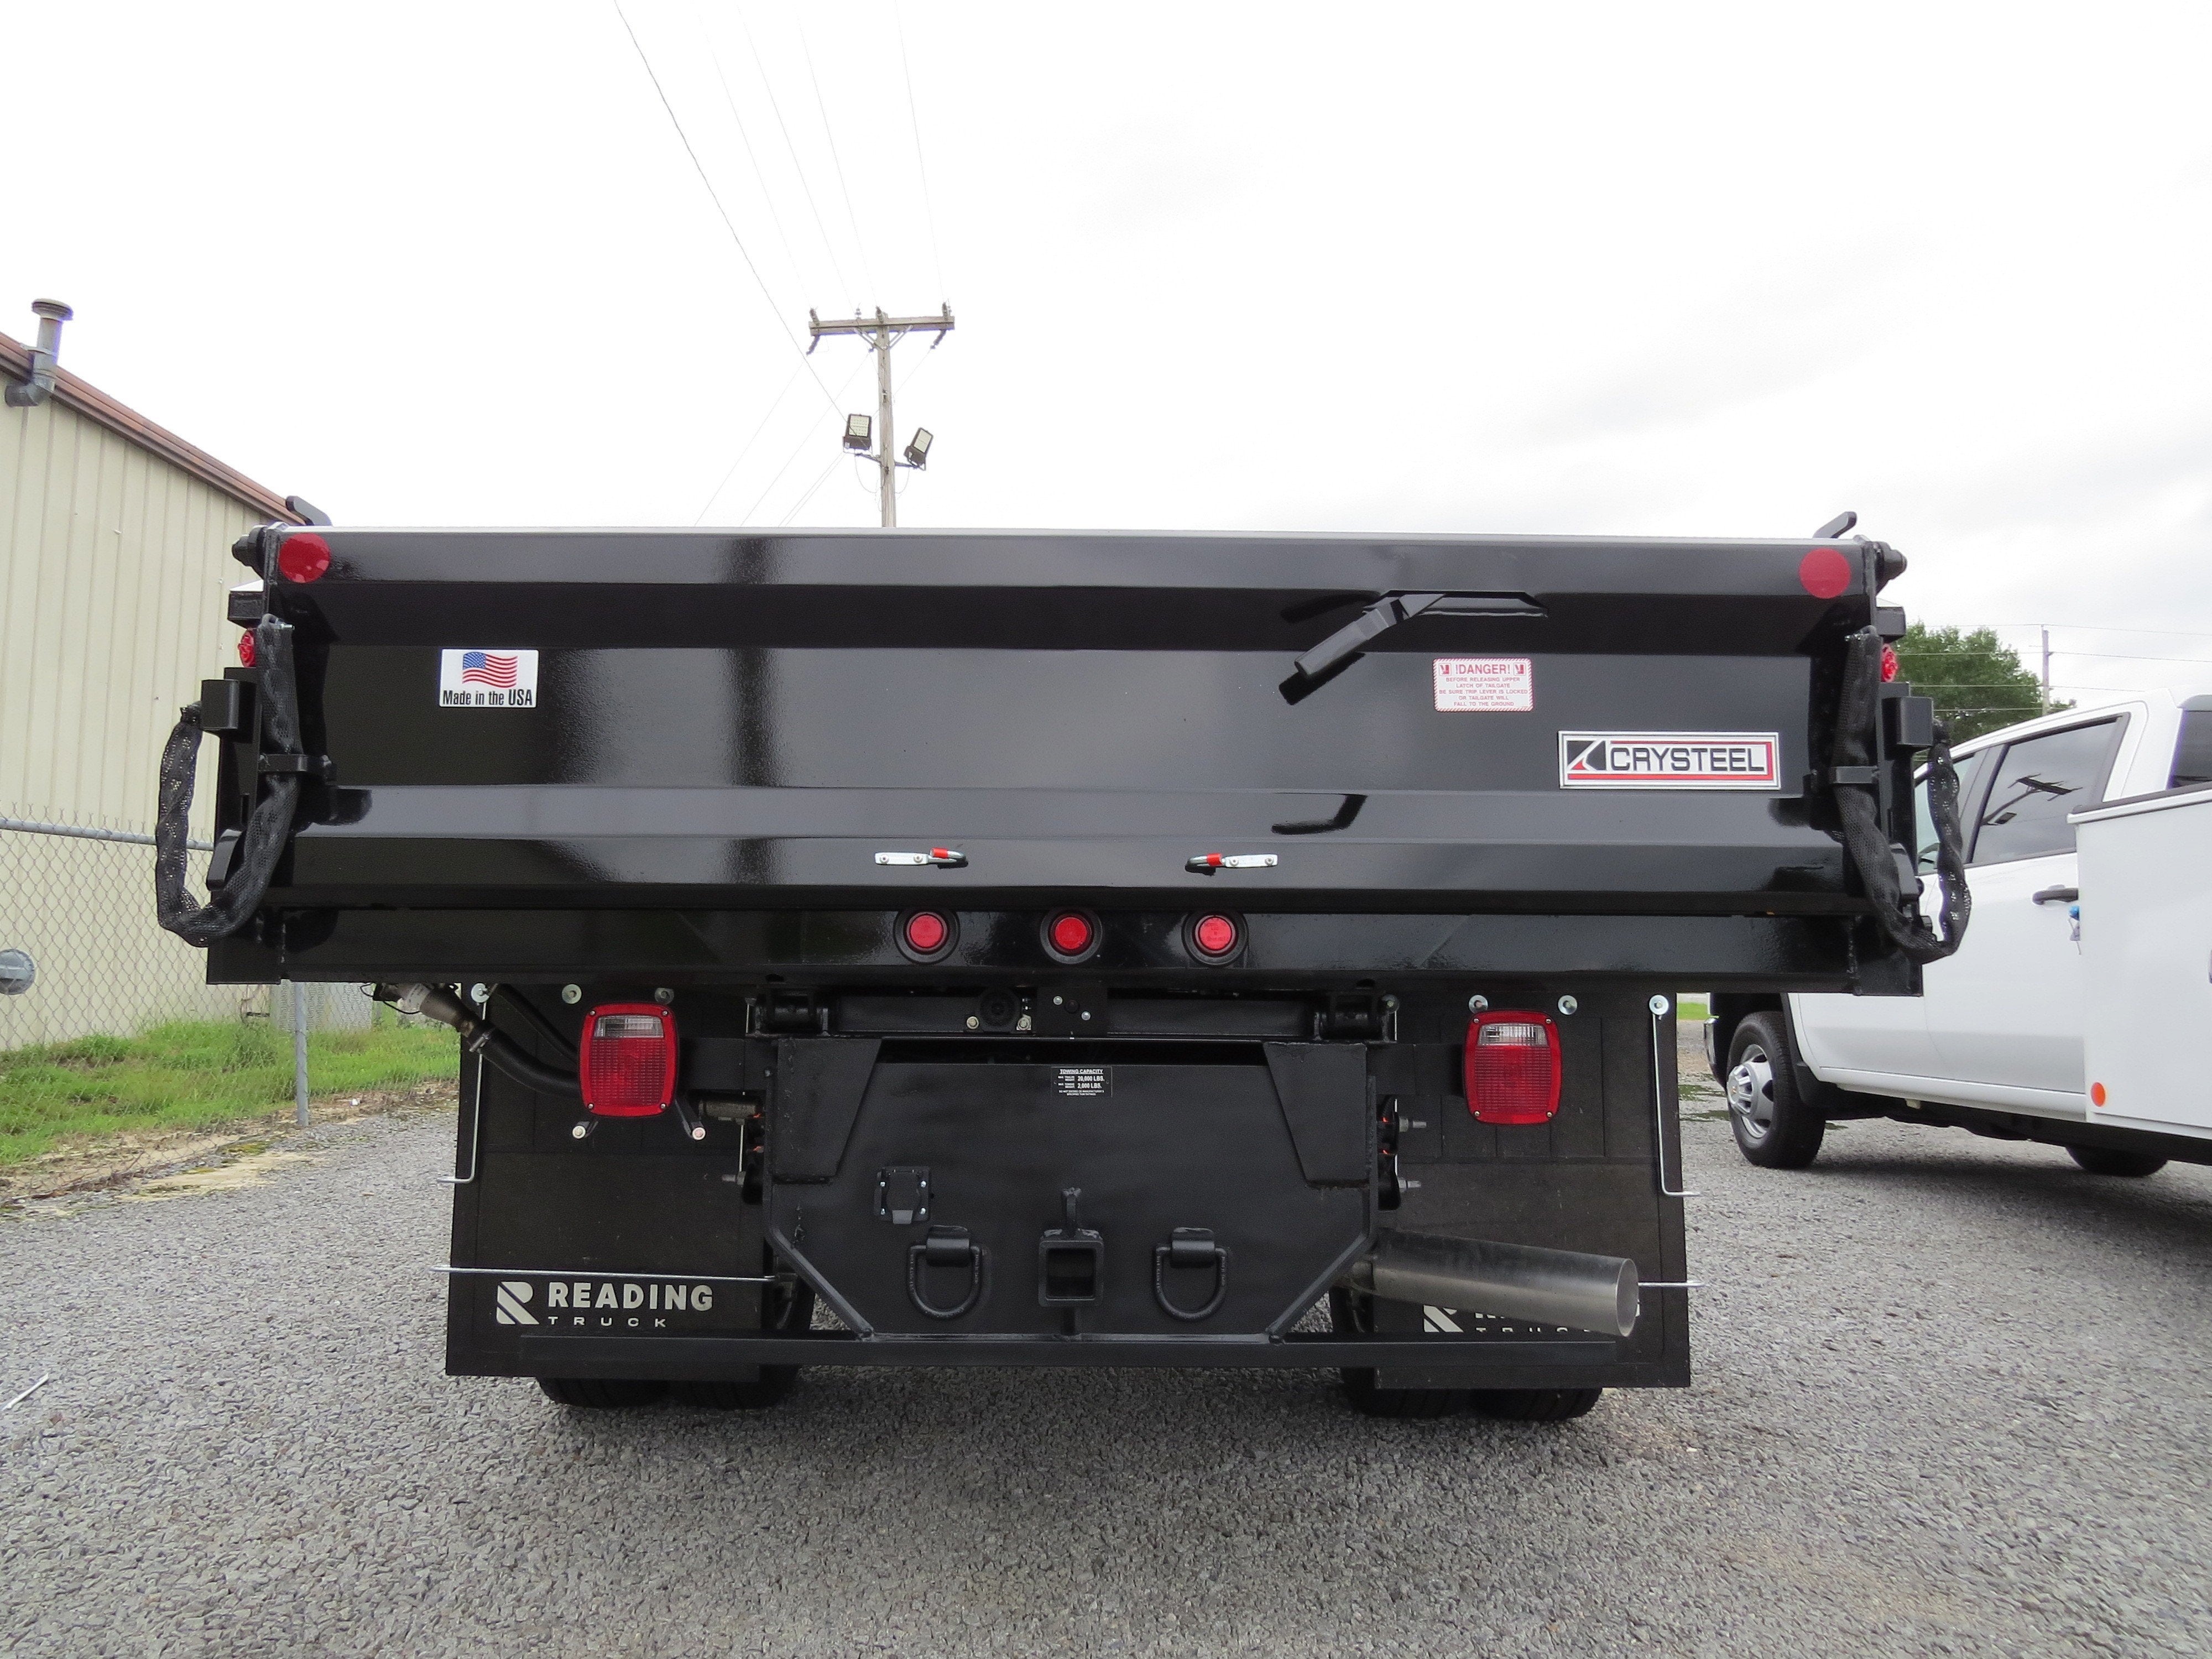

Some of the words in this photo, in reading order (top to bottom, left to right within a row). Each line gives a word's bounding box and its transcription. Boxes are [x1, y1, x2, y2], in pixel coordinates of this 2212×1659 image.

[1455, 664, 1510, 674] !DANGER!
[443, 690, 471, 705] Made
[476, 691, 485, 705] in
[489, 691, 504, 705] the
[508, 689, 533, 706] USA
[1610, 747, 1765, 771] CRYSTEEL
[548, 1281, 713, 1312] READING
[547, 1316, 666, 1328] TRUCK
